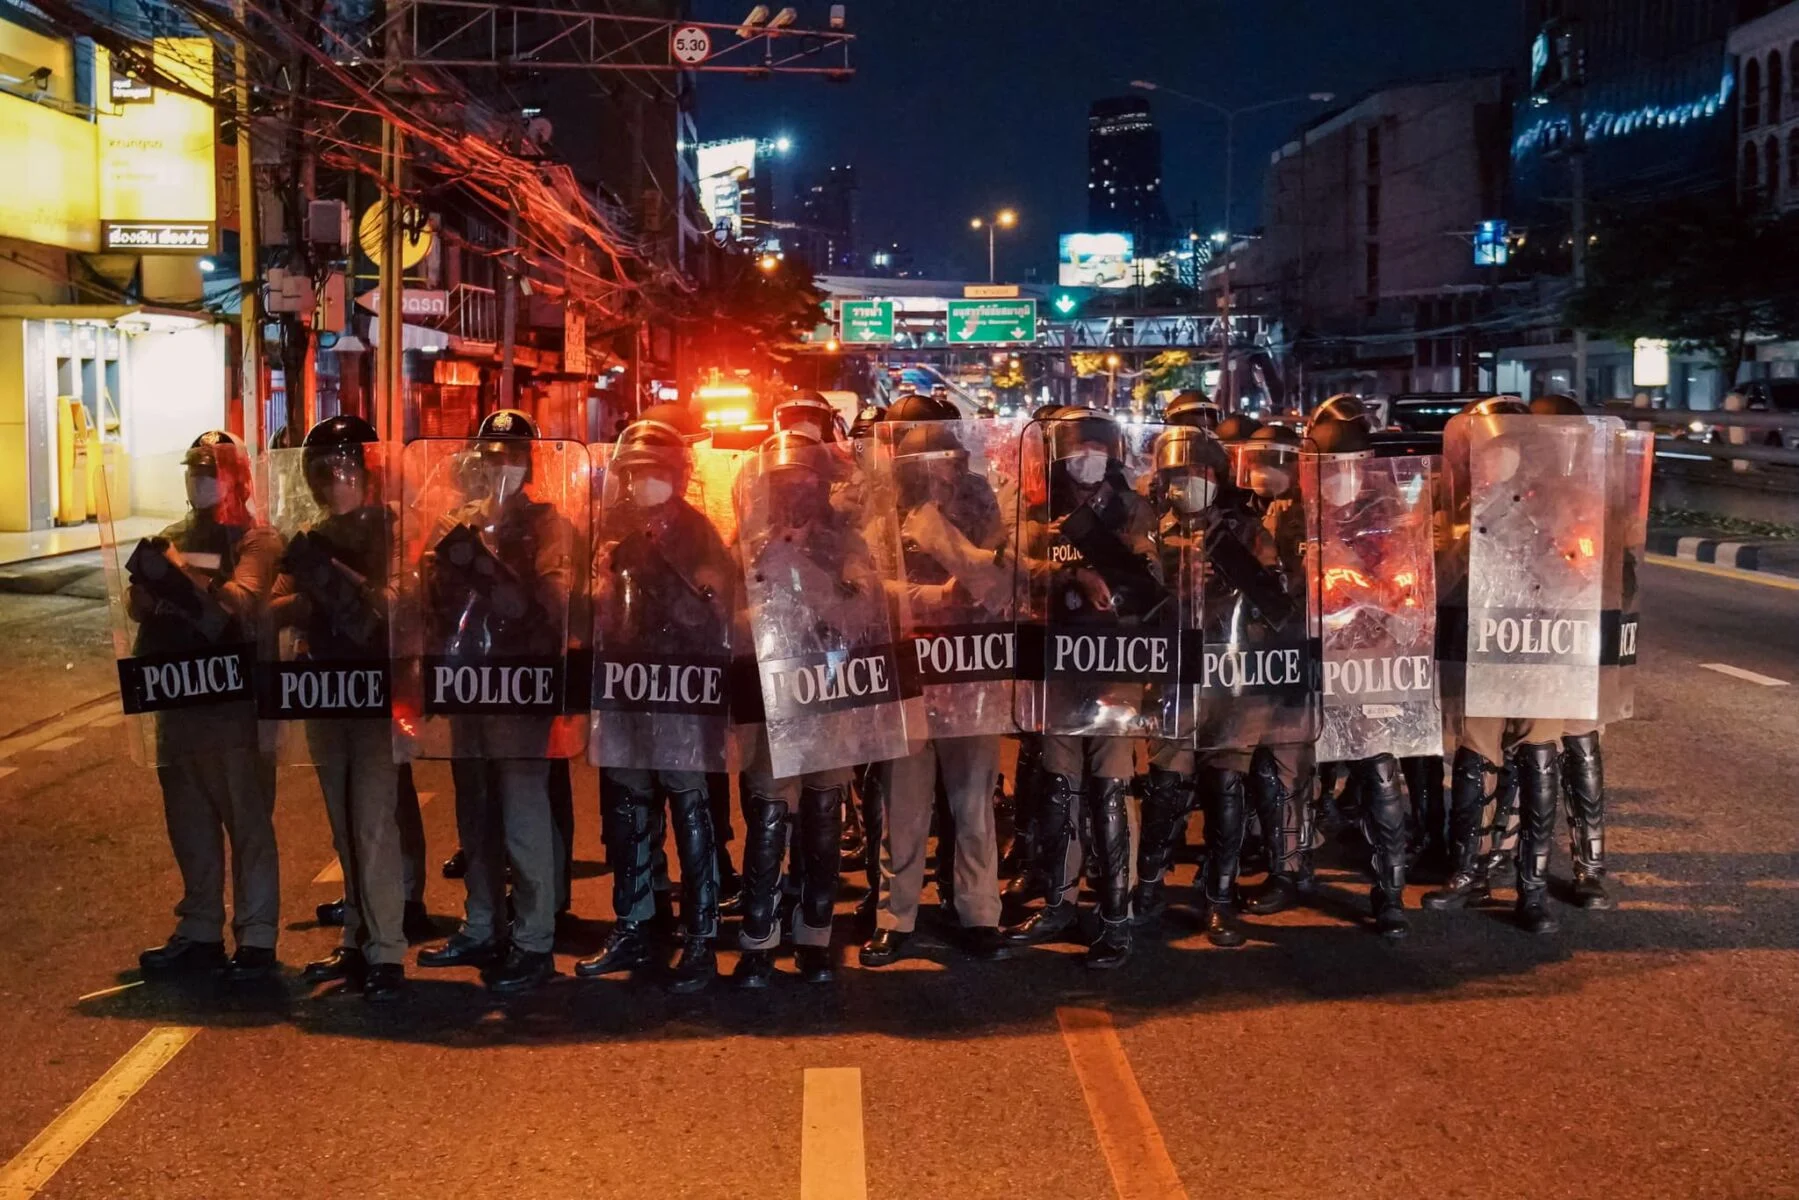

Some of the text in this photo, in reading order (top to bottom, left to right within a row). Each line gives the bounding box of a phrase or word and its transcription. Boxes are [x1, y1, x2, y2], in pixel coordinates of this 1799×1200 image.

[676, 38, 706, 51] 5.30
[1053, 635, 1169, 673] POLICE
[1202, 648, 1301, 688] POLICE
[142, 654, 244, 702] POLICE
[280, 670, 384, 709] POLICE
[433, 665, 554, 704] POLICE
[602, 662, 721, 704] POLICE
[1322, 655, 1432, 696] POLICE
